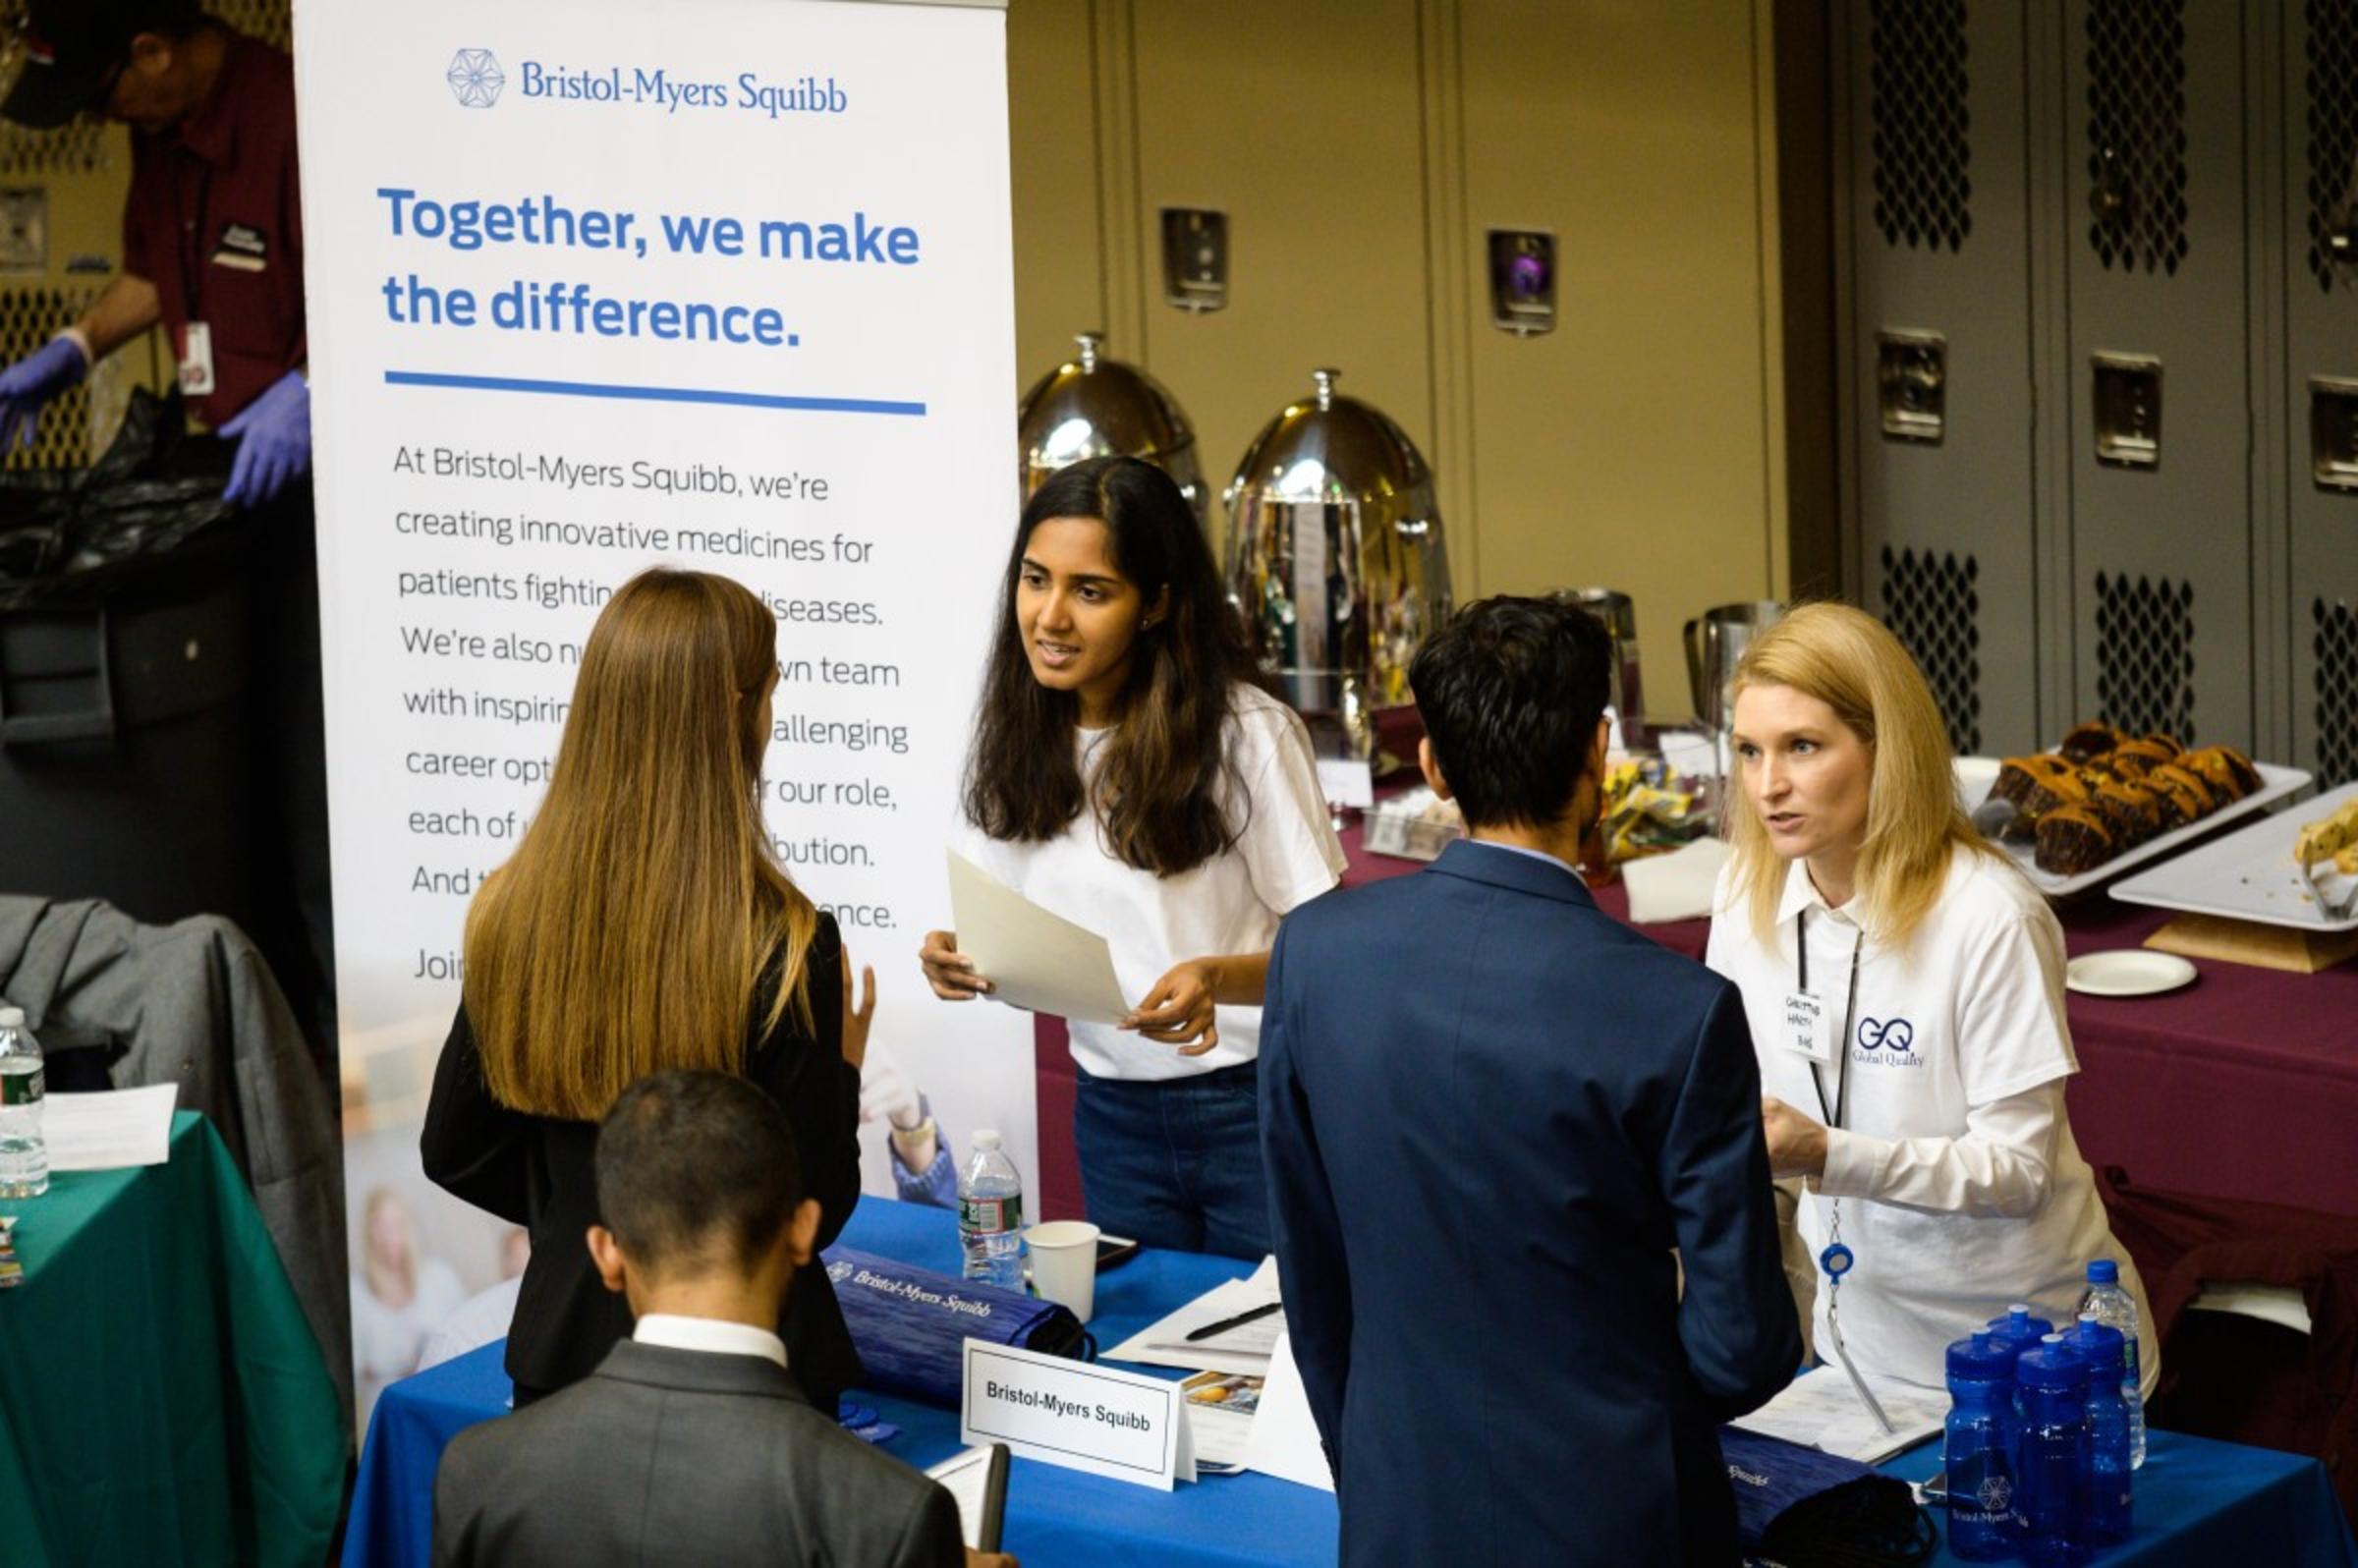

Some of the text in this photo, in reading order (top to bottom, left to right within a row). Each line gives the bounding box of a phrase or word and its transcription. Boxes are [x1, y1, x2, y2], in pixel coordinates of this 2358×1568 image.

[522, 62, 847, 118] Bristol-Myers Squibb
[377, 188, 920, 265] Together, we make
[382, 275, 800, 347] the difference.
[393, 446, 828, 500] At Bristol-Myers Squibb, we're
[395, 510, 873, 563] creating innovative medicines for
[399, 570, 518, 600] patients
[525, 573, 612, 609] fightin
[400, 626, 485, 658] We're
[493, 633, 553, 663] also
[820, 656, 899, 687] team
[403, 688, 909, 754] with inspirin allenging
[406, 752, 496, 779] career
[779, 781, 826, 804] our
[835, 777, 897, 812] role,
[409, 808, 480, 836] each
[486, 811, 516, 839] of
[772, 833, 875, 867] bution.
[412, 866, 470, 895] And
[1858, 1017, 1914, 1051] GQ
[1885, 1052, 1925, 1068] Quality
[853, 1269, 991, 1317] Bristol-Myers Squibb
[986, 1380, 1151, 1431] Bristol-Myers Squibb
